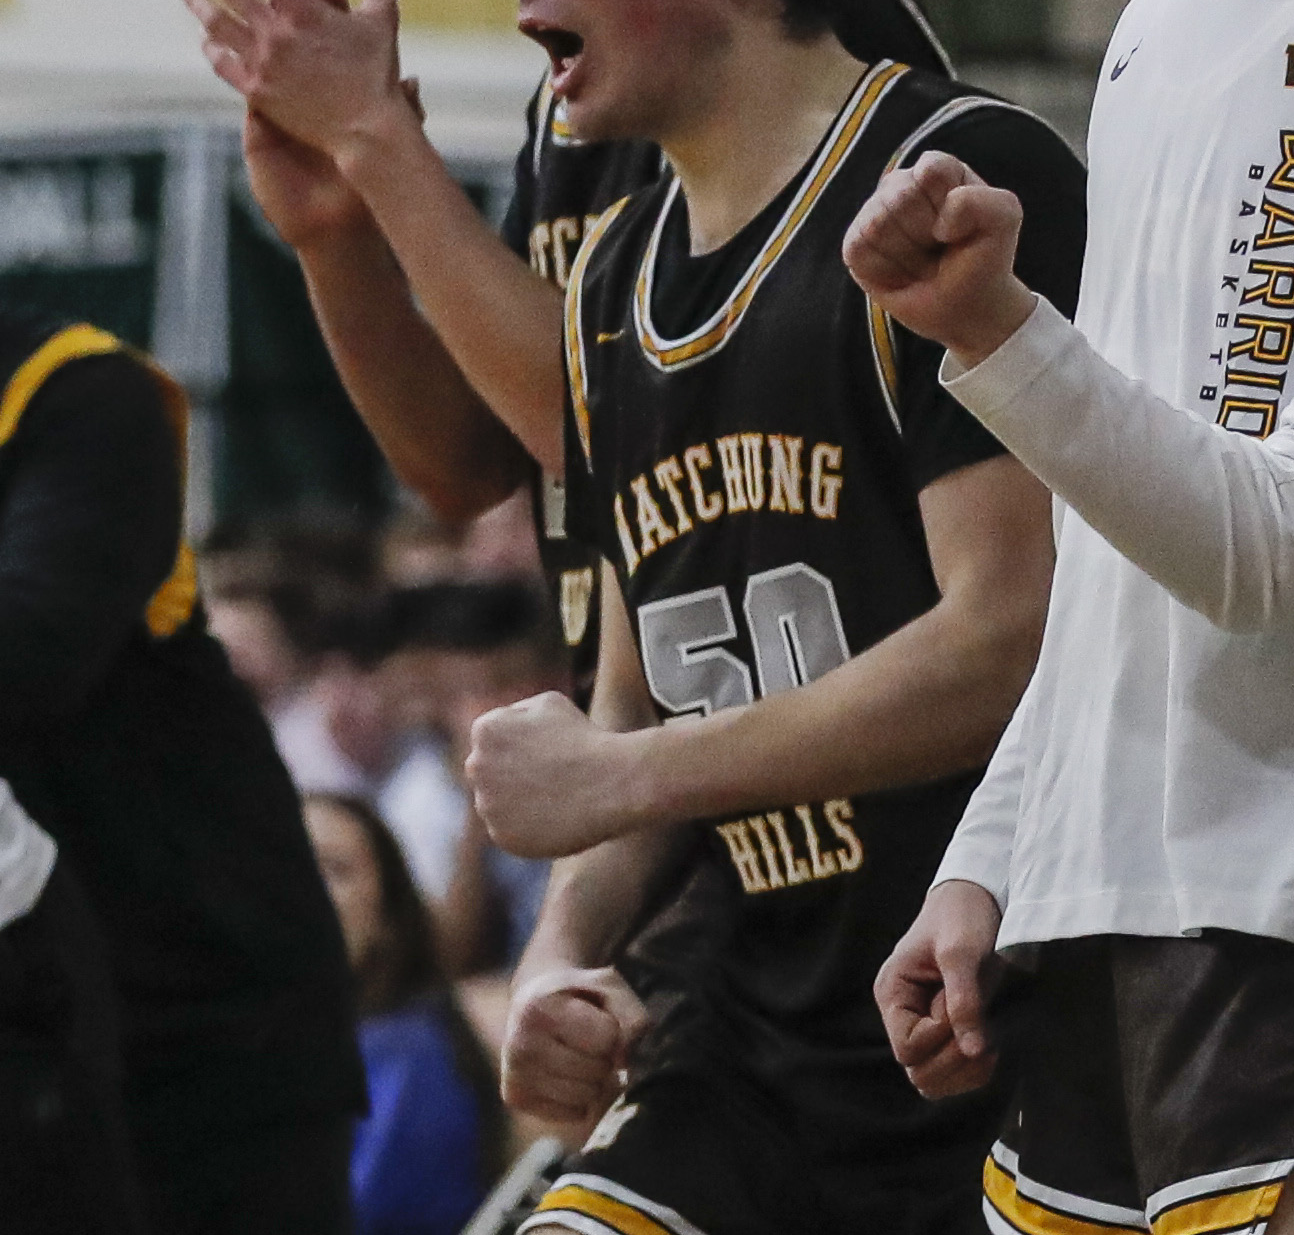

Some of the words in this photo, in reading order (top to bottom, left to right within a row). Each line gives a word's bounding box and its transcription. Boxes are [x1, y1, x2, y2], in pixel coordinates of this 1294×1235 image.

[1199, 164, 1265, 401] BASKETB
[636, 562, 851, 726] 50
[716, 797, 864, 894] HILLS
